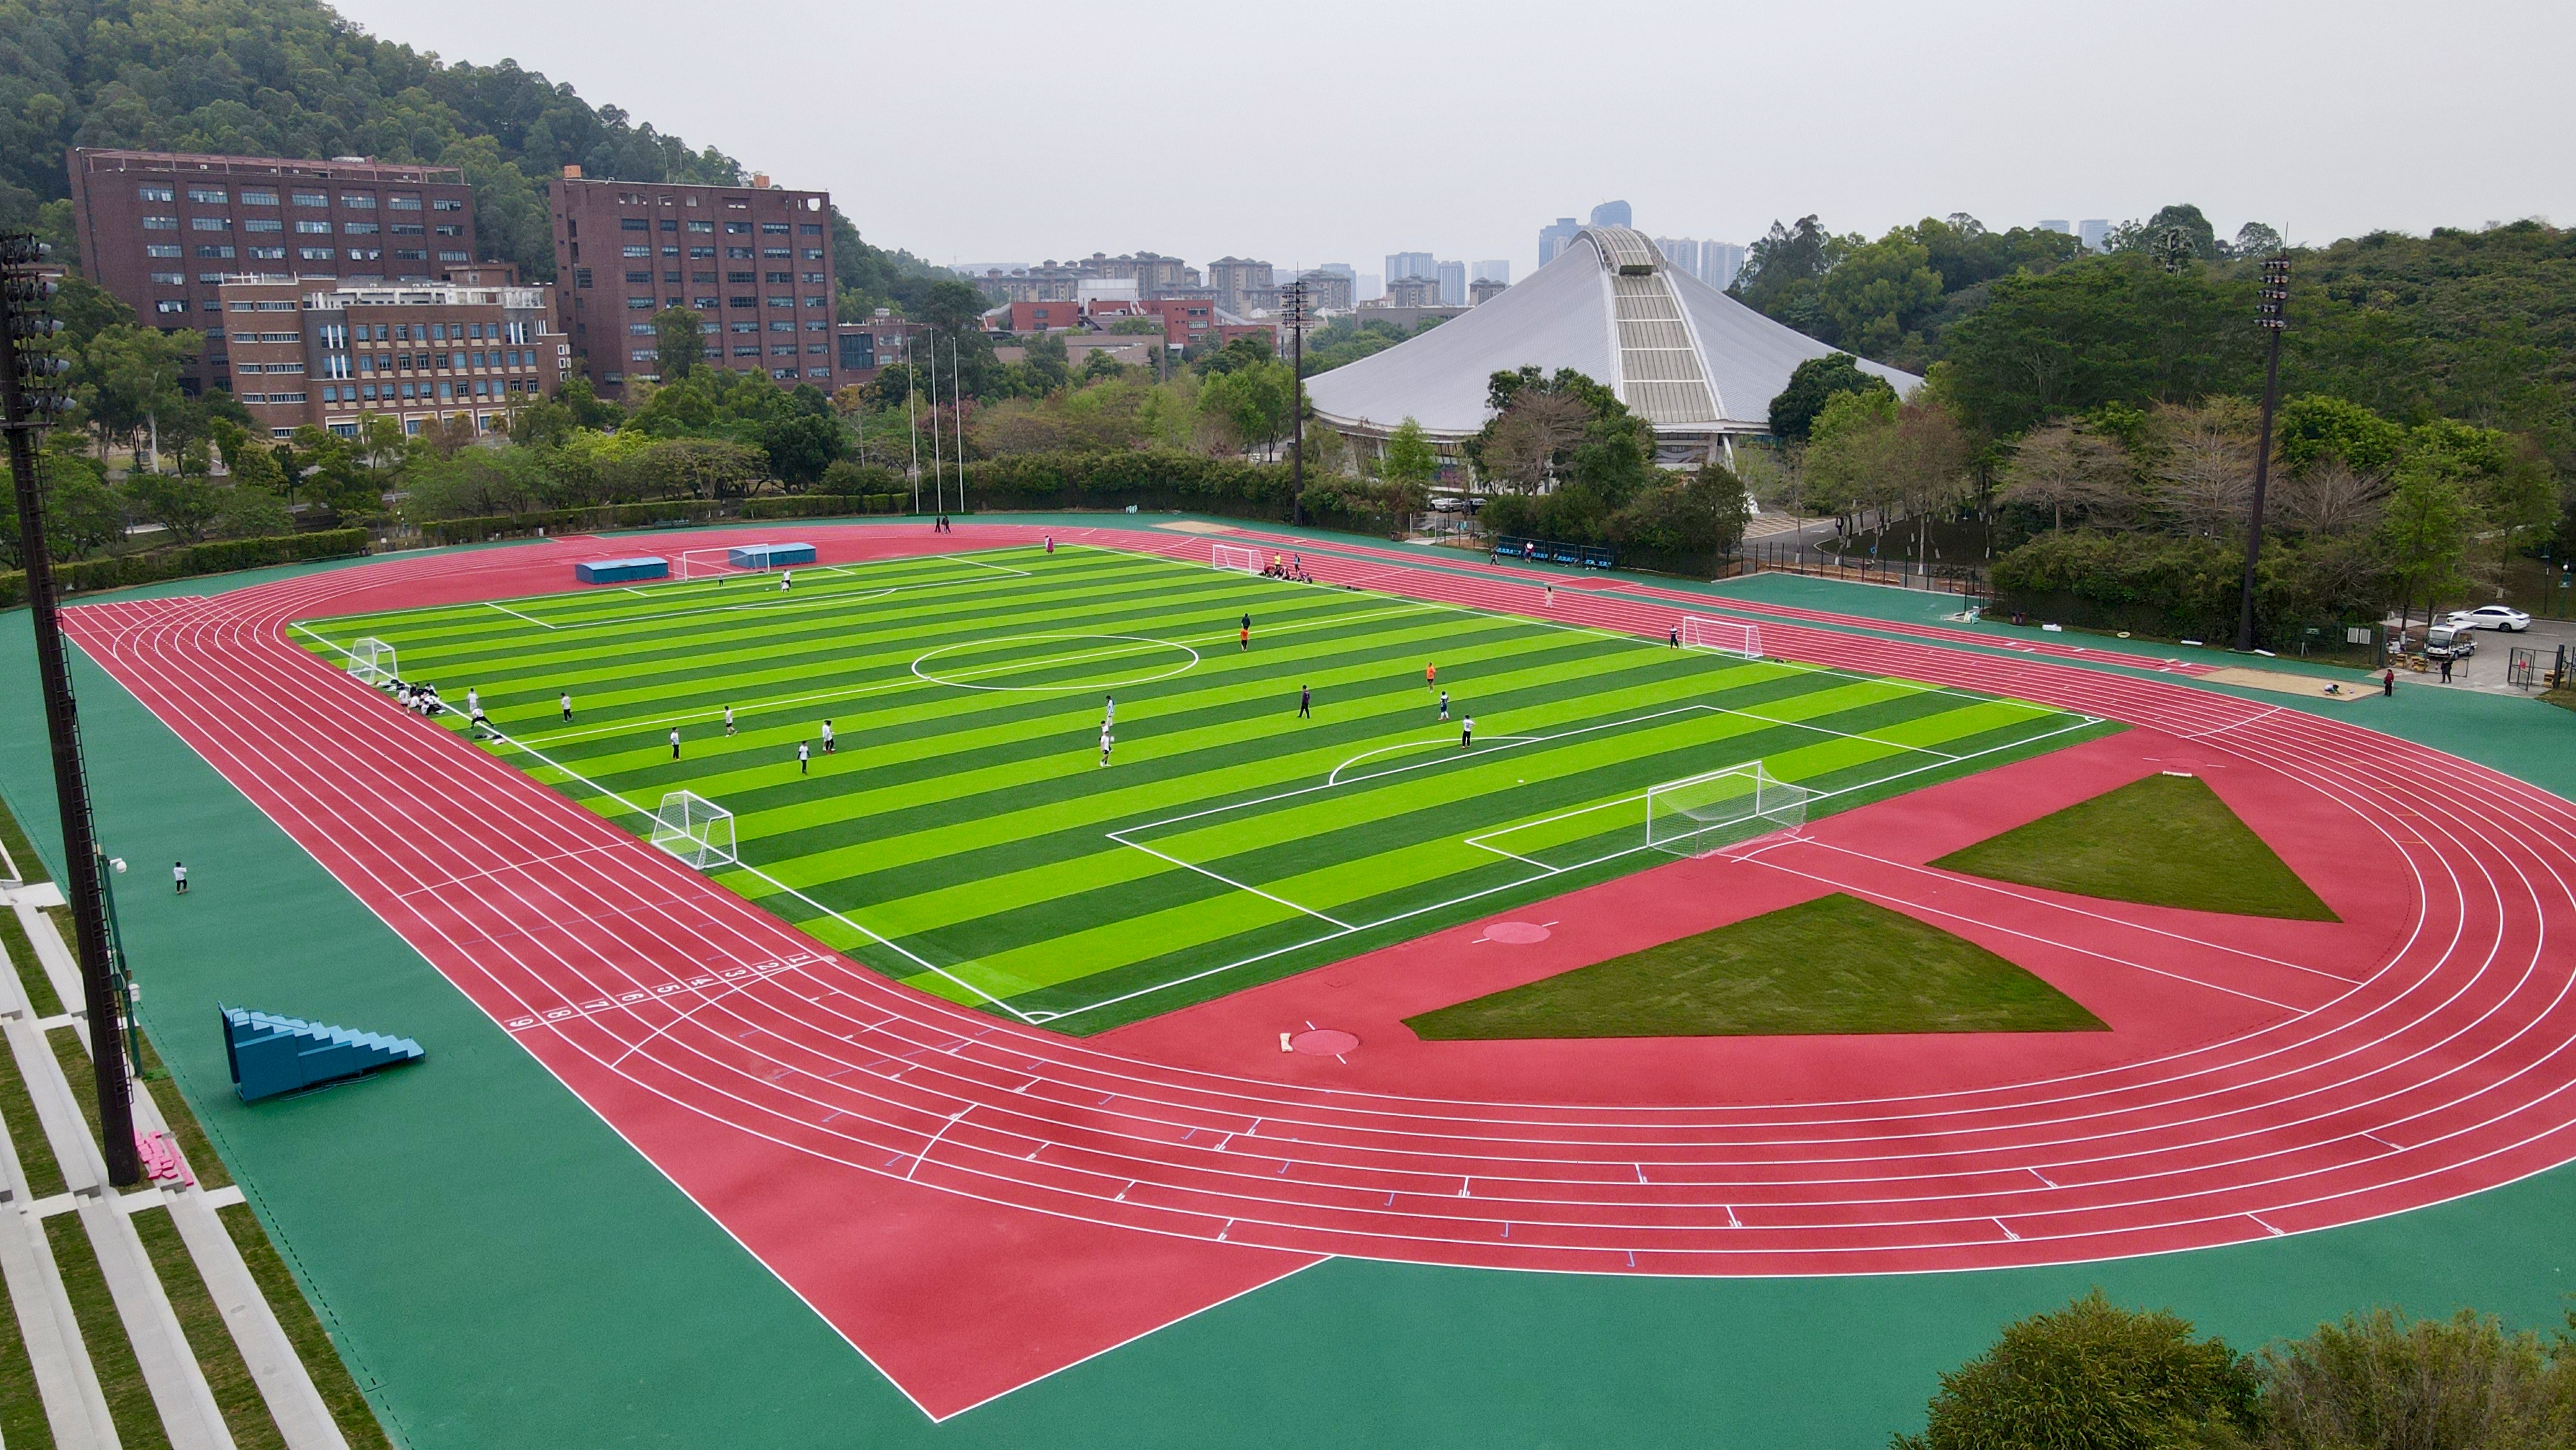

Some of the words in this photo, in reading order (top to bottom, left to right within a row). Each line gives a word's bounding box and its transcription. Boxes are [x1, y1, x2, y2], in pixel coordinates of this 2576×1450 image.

[788, 955, 811, 963] 1
[724, 969, 746, 977] 3
[690, 977, 714, 986] 4
[657, 984, 681, 993] 5
[621, 993, 645, 1002] 6
[584, 1001, 610, 1009] 7
[547, 1010, 572, 1019] 8
[509, 1019, 534, 1027] 9
